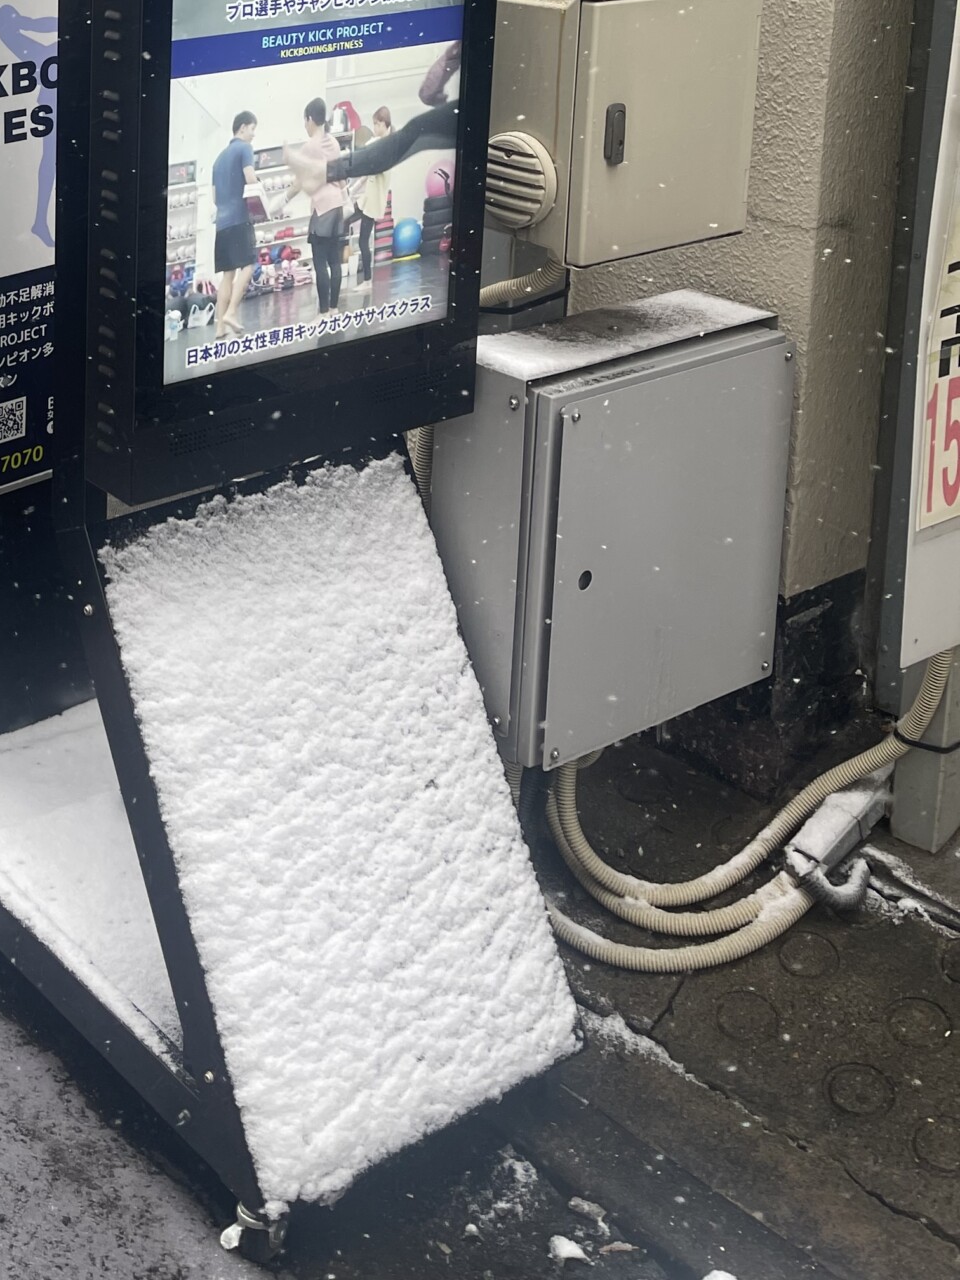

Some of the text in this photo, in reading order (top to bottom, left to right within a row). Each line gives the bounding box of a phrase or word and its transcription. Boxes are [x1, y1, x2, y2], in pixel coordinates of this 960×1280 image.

[262, 22, 384, 49] BEAUTY KICK PROJECT
[280, 39, 364, 59] KICKBOXING&FITNESS
[186, 295, 432, 366] 日本初の女性専用キックボクササイズクラス
